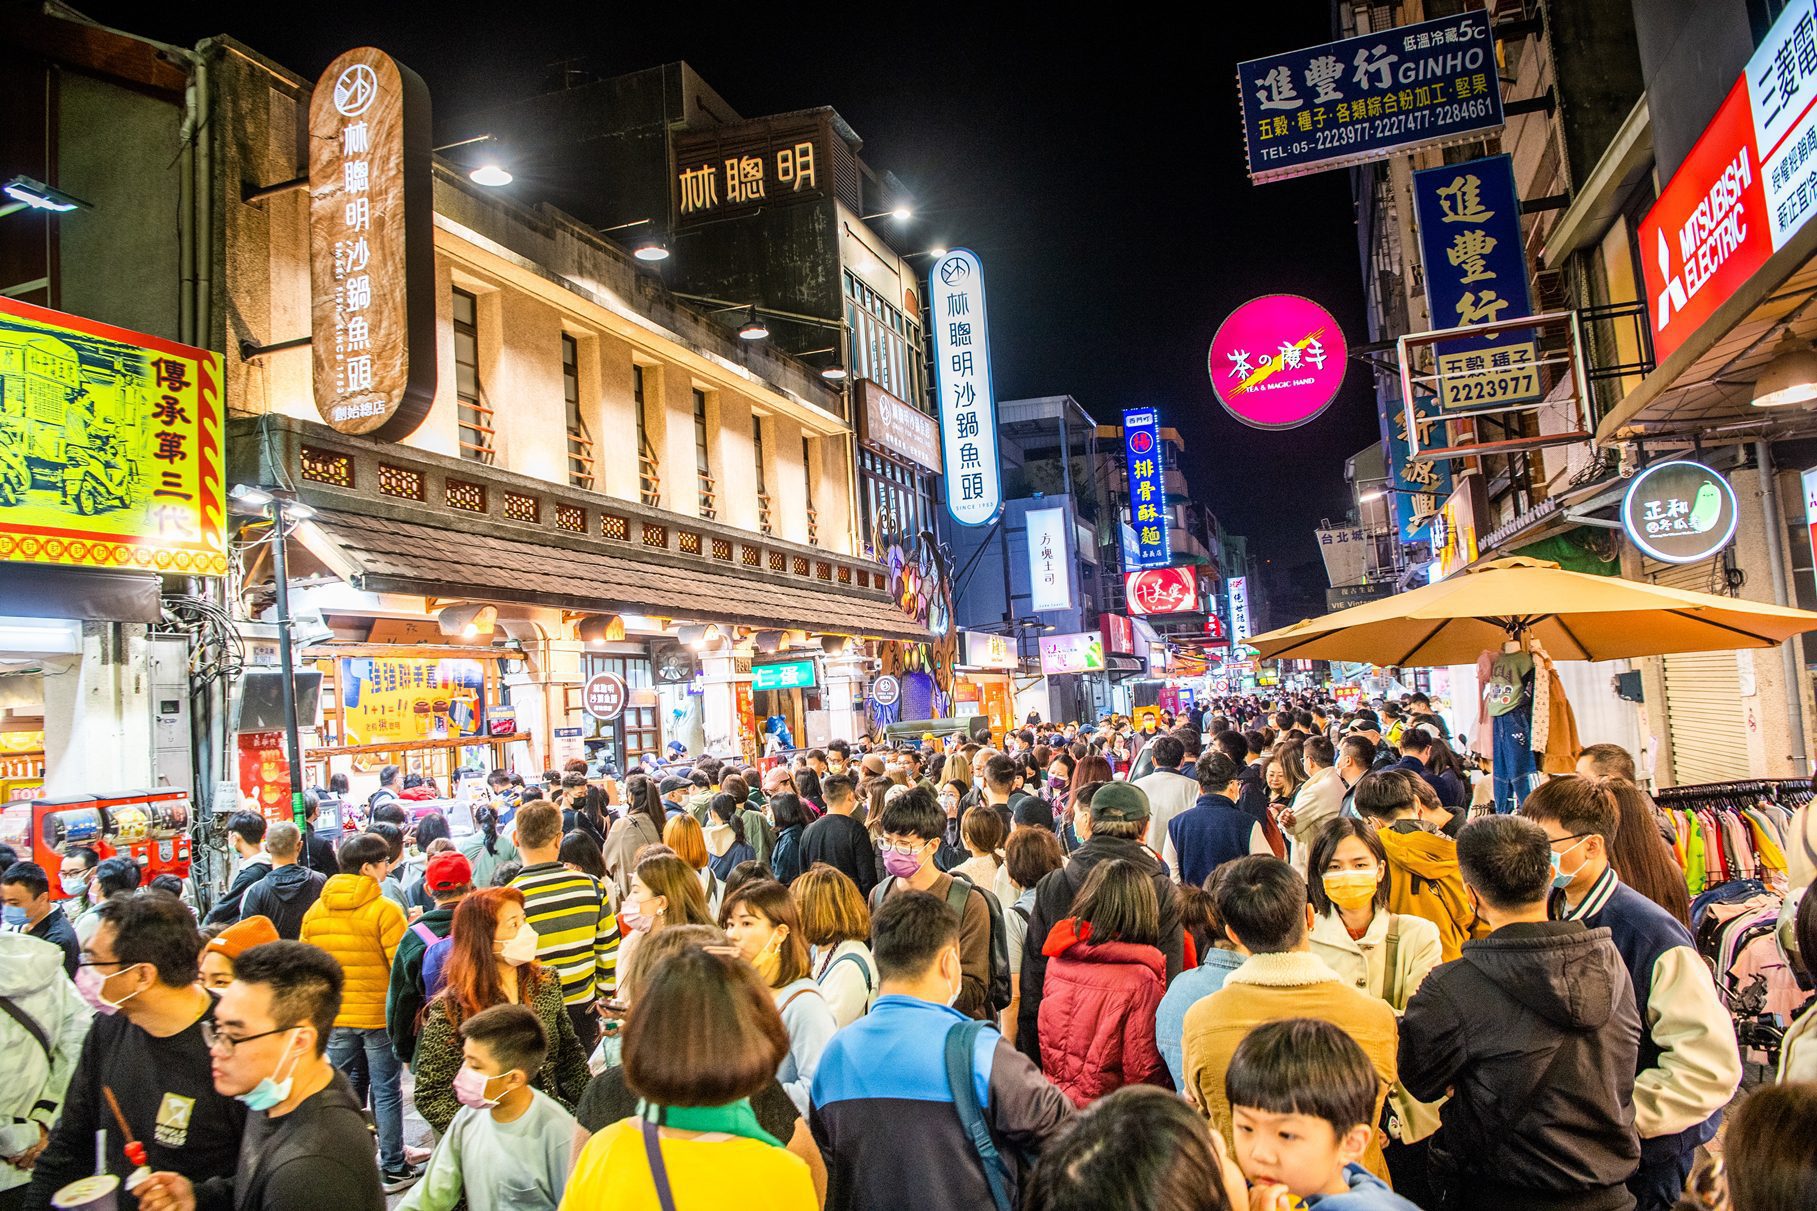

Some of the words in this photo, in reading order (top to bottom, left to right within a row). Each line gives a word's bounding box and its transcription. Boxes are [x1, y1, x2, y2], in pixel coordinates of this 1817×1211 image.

[1255, 44, 1399, 110] 進豐行
[1398, 47, 1484, 84] GINHO
[679, 142, 816, 215] 林聰明
[1679, 145, 1751, 263] MITSUBISHI
[343, 121, 372, 392] 林聰明沙鍋魚頭
[1436, 174, 1509, 340] 進豐行
[1684, 203, 1746, 299] ELECTRIC
[1227, 337, 1327, 381] 茶の魔手
[1267, 380, 1292, 390] MAGIC
[1293, 377, 1315, 386] HAND
[1450, 375, 1532, 403] 2223977
[947, 291, 984, 501] 林聰明沙鍋魚頭
[151, 357, 193, 537] 傳承第三代
[1133, 459, 1161, 546] 排骨酥麵
[1321, 530, 1365, 545] 台北城
[1643, 499, 1689, 520] 正和
